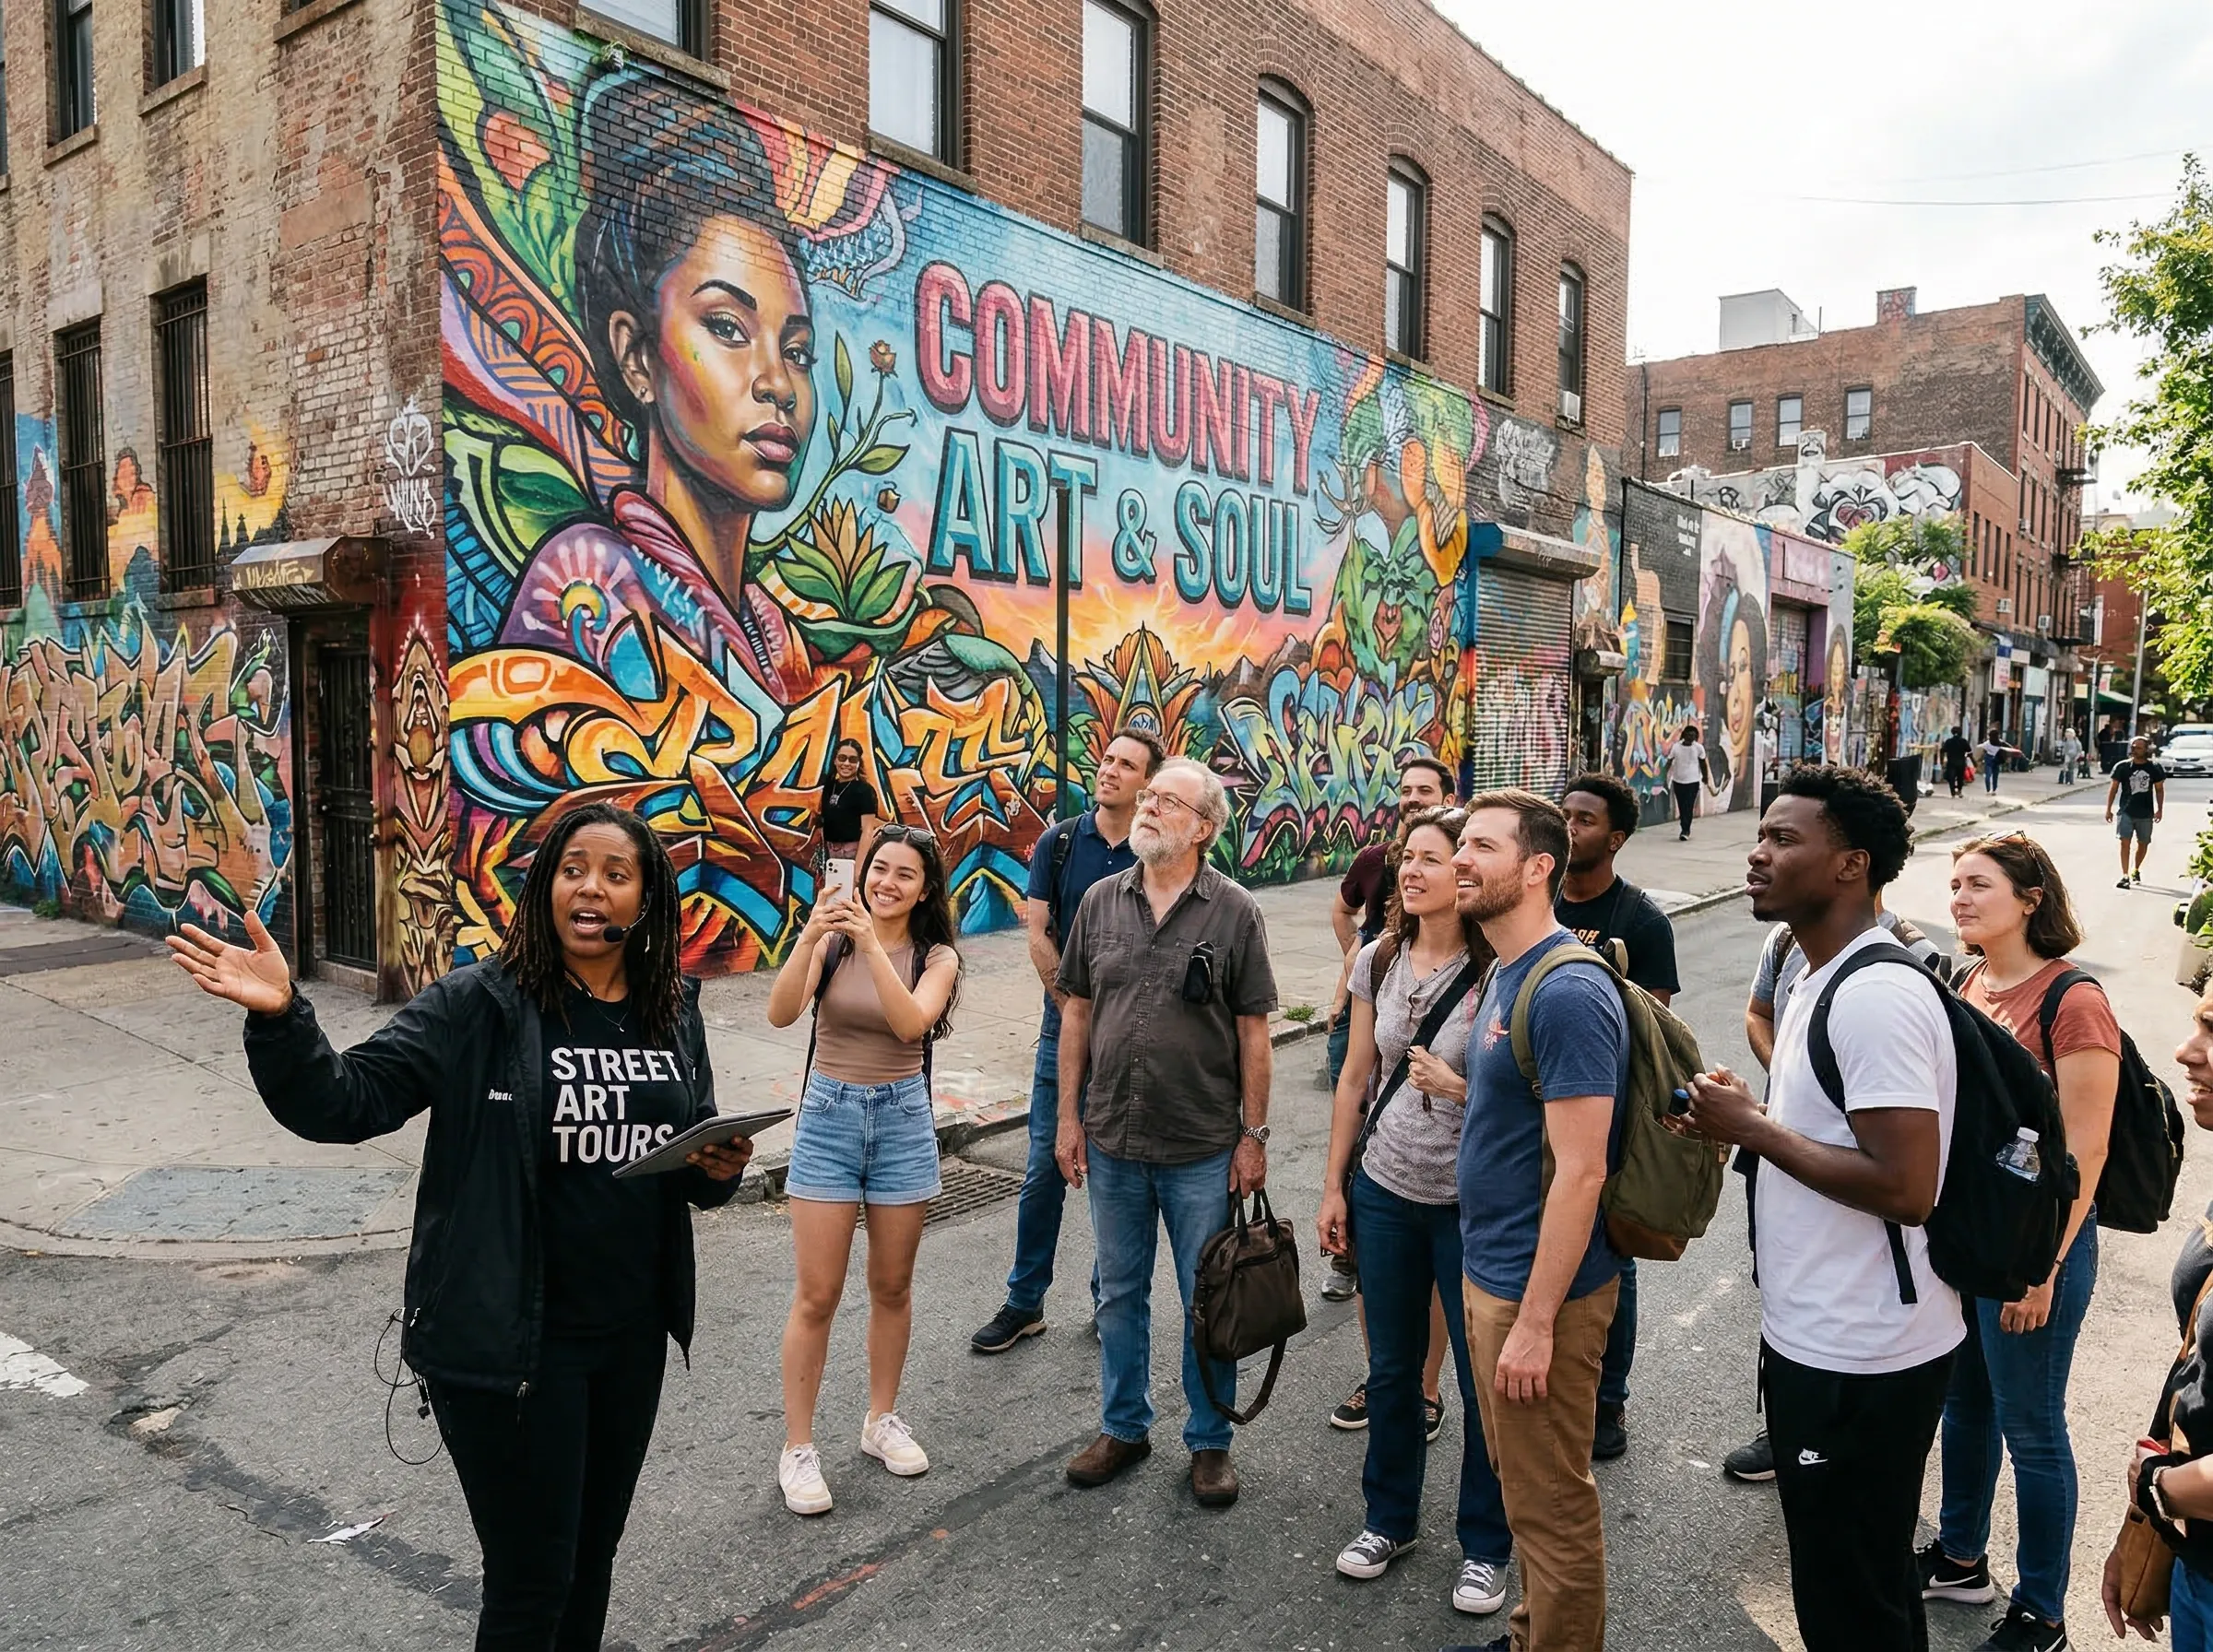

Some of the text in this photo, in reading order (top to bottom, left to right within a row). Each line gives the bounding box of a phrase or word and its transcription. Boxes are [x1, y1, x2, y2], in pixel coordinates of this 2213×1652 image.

[915, 259, 1320, 496] COMMUNITY
[925, 426, 1312, 616] ART & SOUL
[550, 1047, 682, 1082] STREET
[553, 1084, 631, 1122] ART
